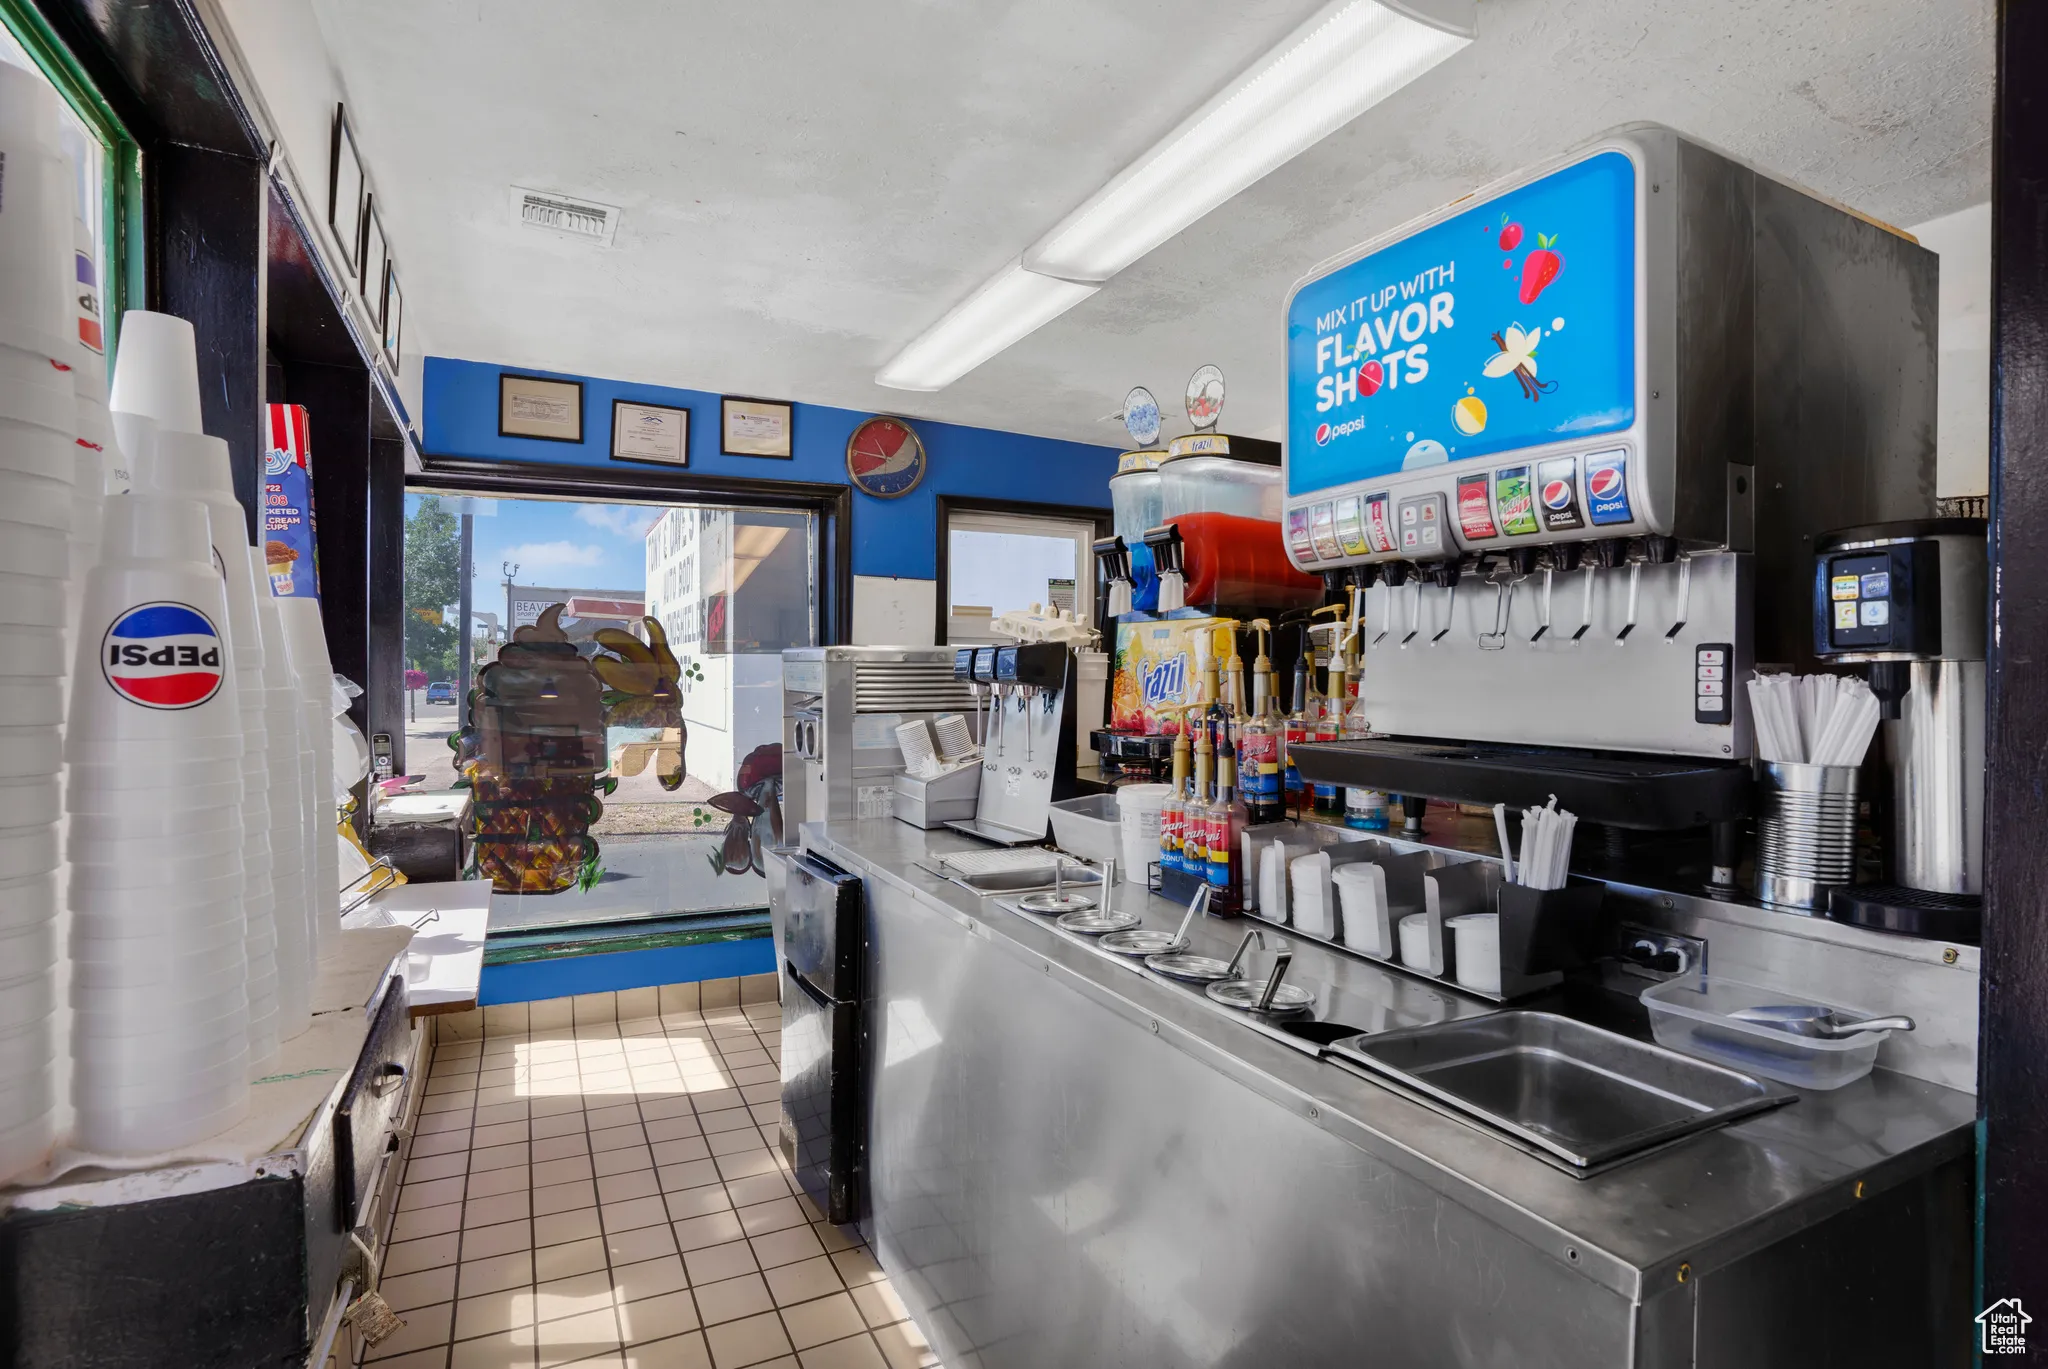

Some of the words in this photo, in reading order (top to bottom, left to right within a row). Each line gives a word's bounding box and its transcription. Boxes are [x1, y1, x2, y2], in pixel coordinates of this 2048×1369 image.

[1316, 305, 1347, 335] MIX
[1351, 296, 1367, 322] IT
[1371, 285, 1397, 312] UP
[1400, 260, 1455, 300] WITH
[1316, 291, 1455, 375] FLAVOR
[1331, 415, 1365, 440] pepsi
[1549, 511, 1573, 521] pepsi
[1595, 500, 1624, 513] pepsi
[679, 552, 694, 598] BODY
[110, 645, 219, 668] PEPSI
